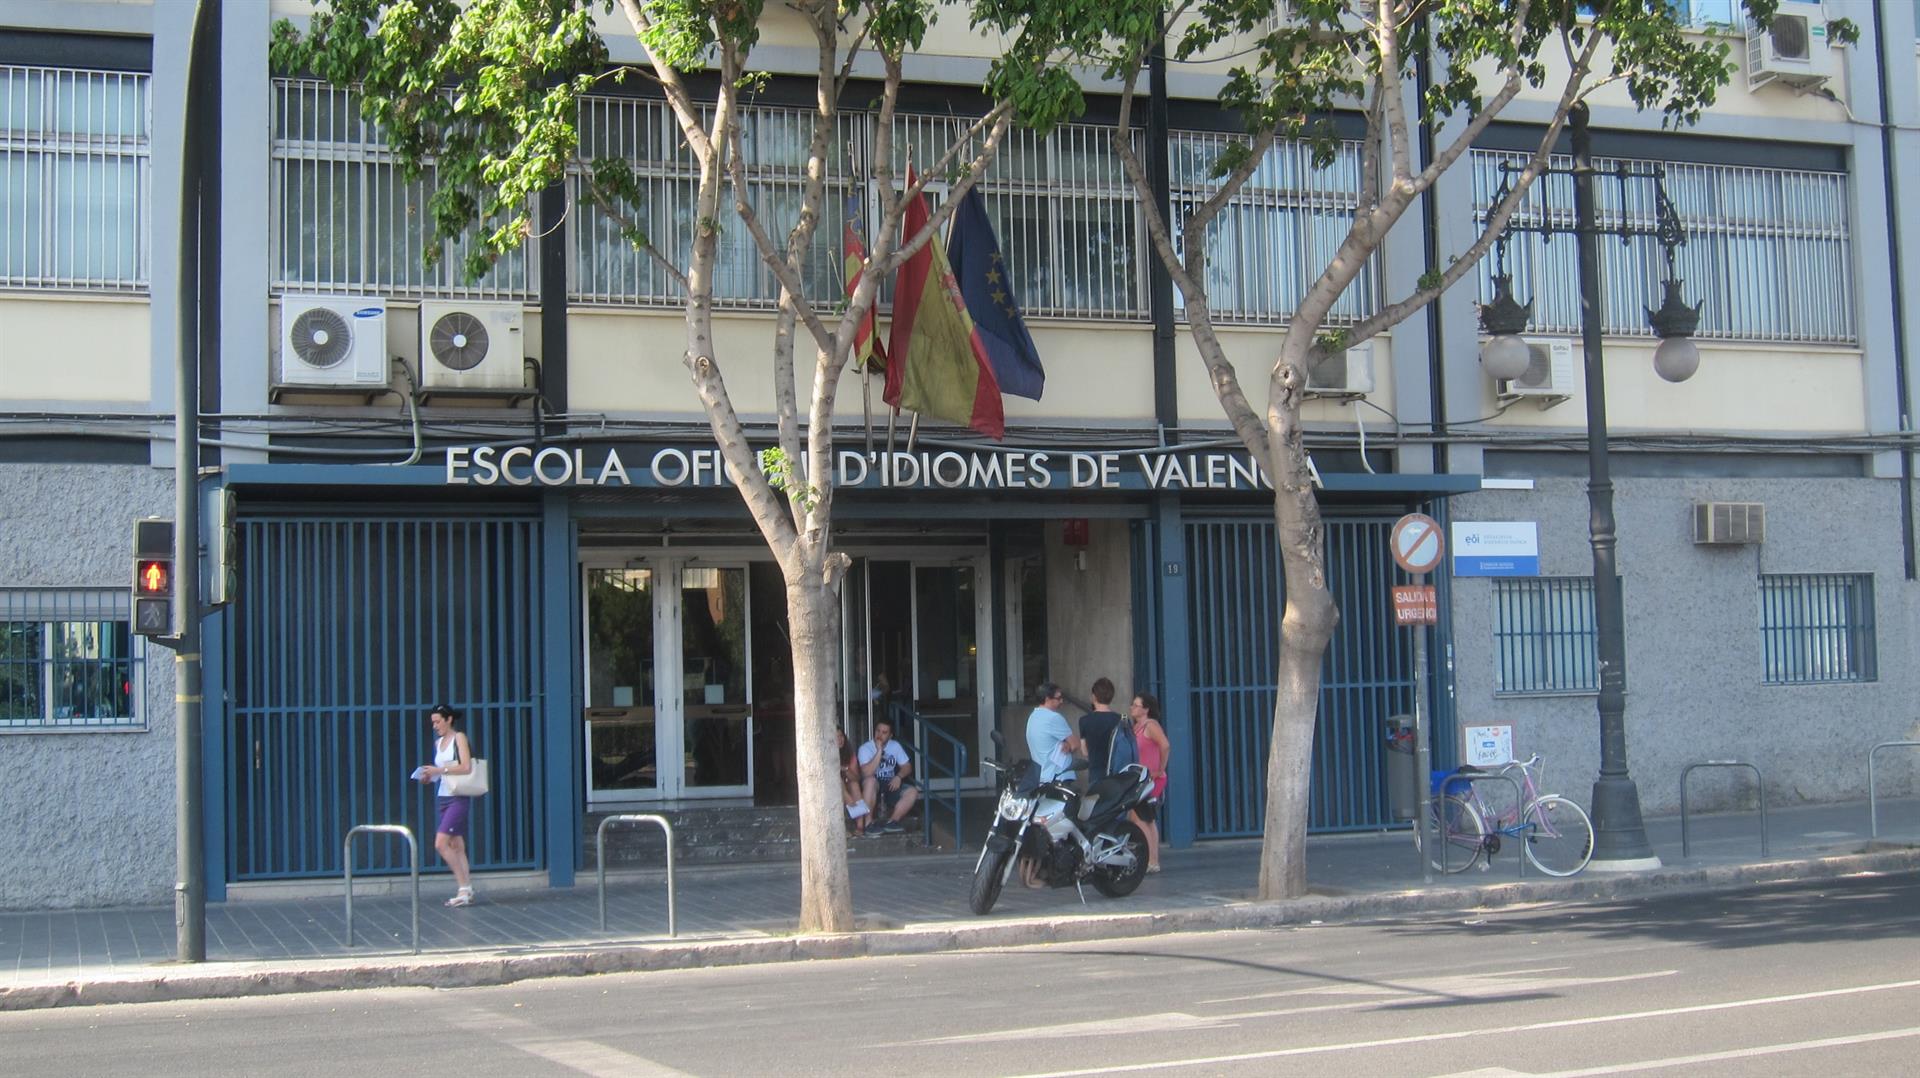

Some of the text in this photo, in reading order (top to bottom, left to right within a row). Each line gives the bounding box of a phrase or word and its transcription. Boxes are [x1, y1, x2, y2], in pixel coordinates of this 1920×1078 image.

[446, 446, 631, 486] ESCOLA
[839, 450, 1052, 489] D'IDIOMES
[1072, 453, 1120, 488] DE
[1138, 453, 1324, 489] VALENA
[1395, 591, 1429, 603] SALIDA
